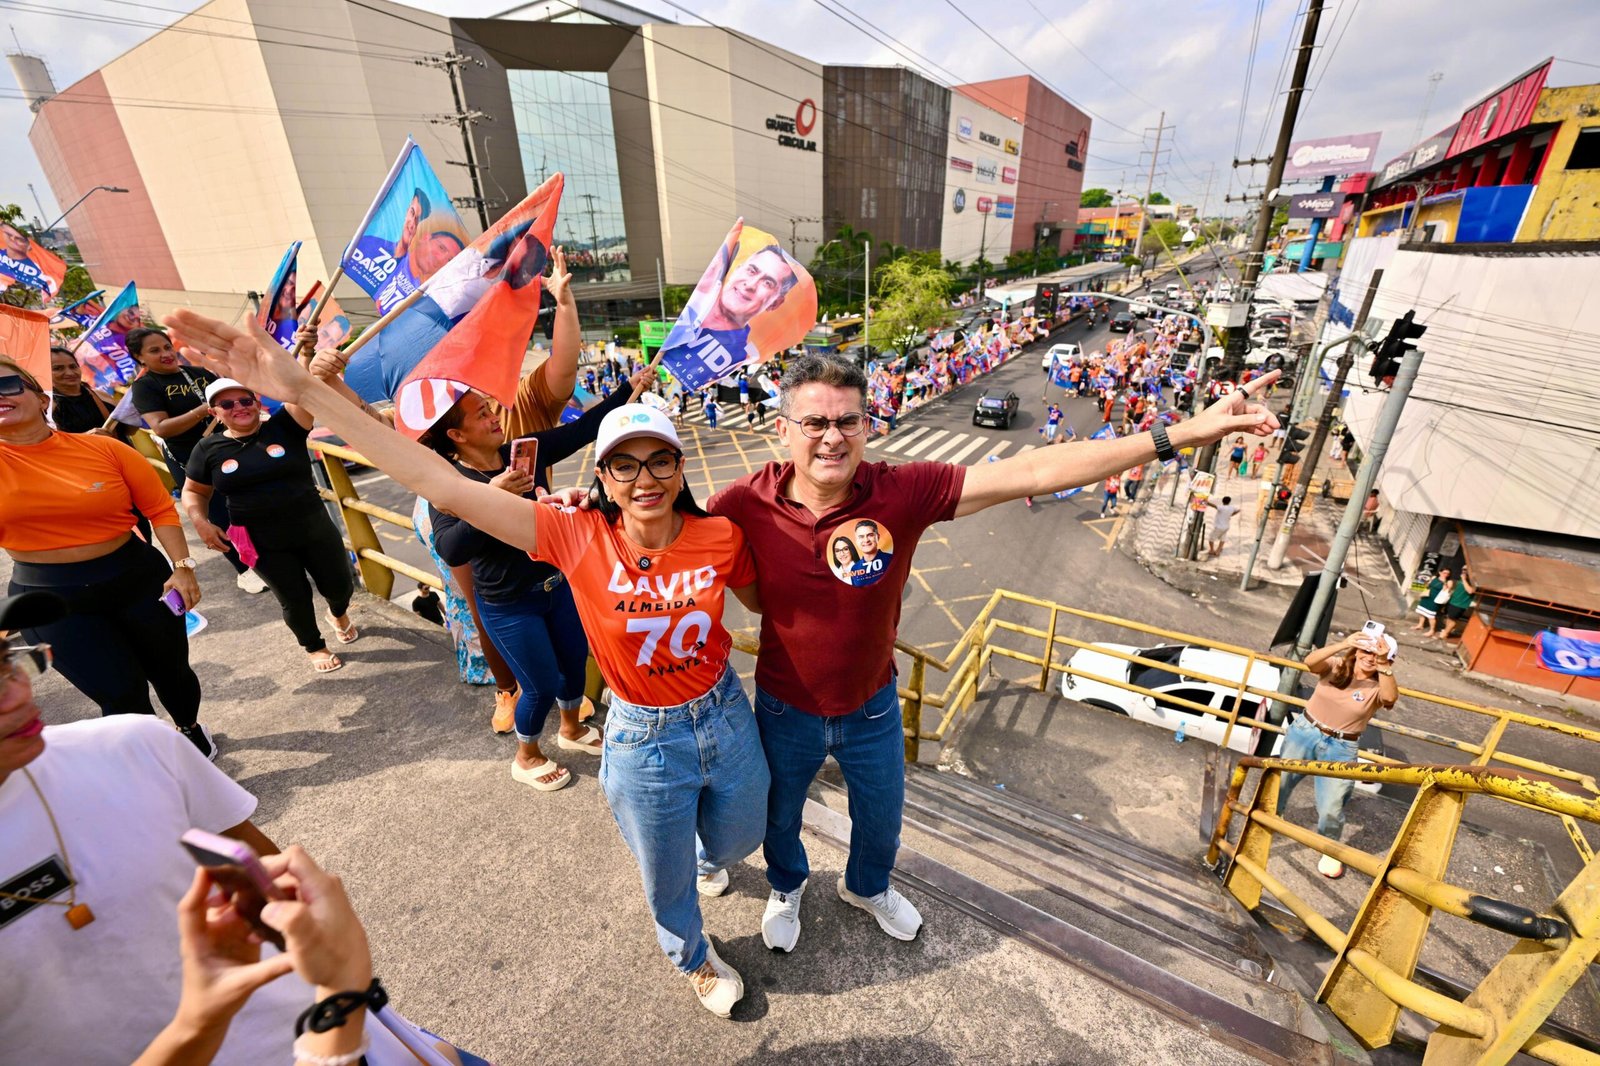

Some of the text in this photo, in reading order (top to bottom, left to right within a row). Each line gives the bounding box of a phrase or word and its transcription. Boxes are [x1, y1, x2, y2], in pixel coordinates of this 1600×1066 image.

[766, 118, 796, 134] GRANDE
[778, 135, 816, 152] CIRCULAR
[0, 253, 38, 276] AVID
[352, 248, 387, 282] DAVID
[372, 247, 397, 274] 70
[842, 569, 866, 578] DAVID
[862, 559, 883, 574] 70
[608, 561, 718, 601] DAVID
[614, 597, 696, 612] ALMEIDA
[626, 610, 712, 667] 70
[648, 657, 701, 677] AVANTE
[0, 874, 55, 910] BOSS
